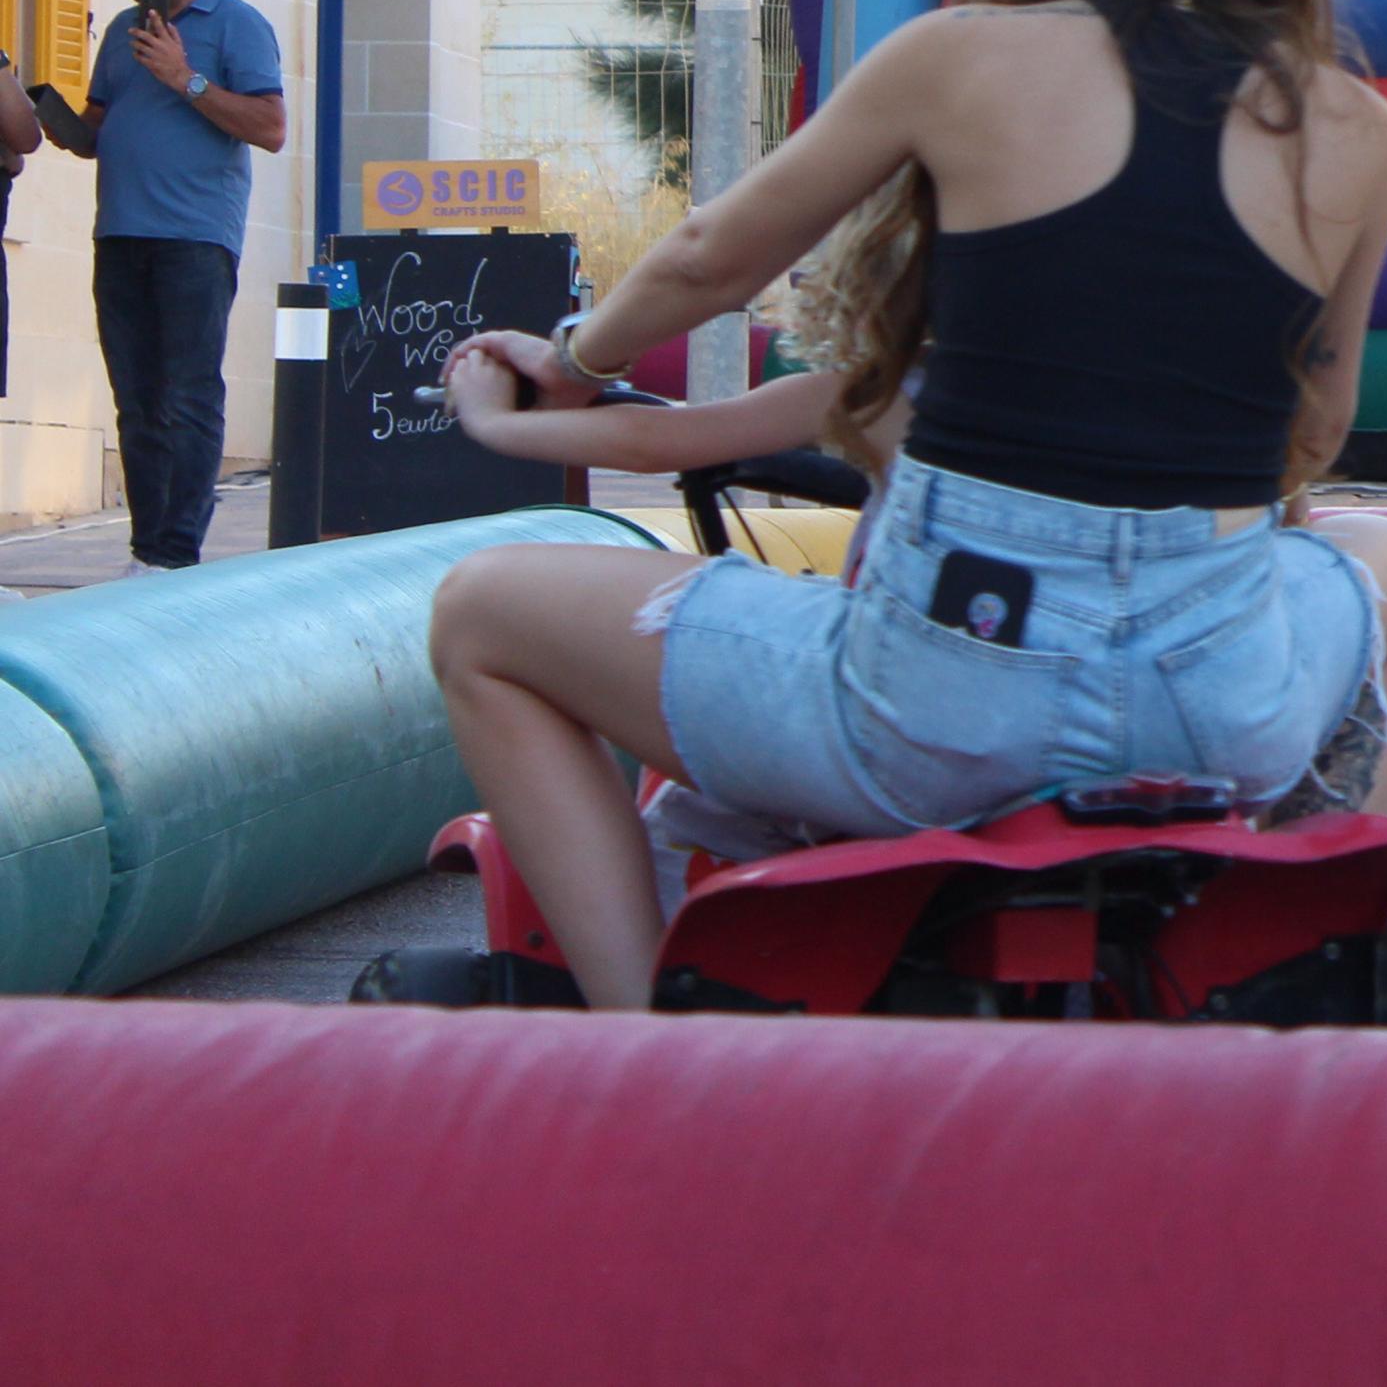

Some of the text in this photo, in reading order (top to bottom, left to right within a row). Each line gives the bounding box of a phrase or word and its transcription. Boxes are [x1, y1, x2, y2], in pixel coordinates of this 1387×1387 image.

[432, 169, 526, 203] SCIC
[432, 204, 527, 217] CRAFTS STUDIO
[357, 251, 489, 335] Wood
[372, 391, 394, 440] 5
